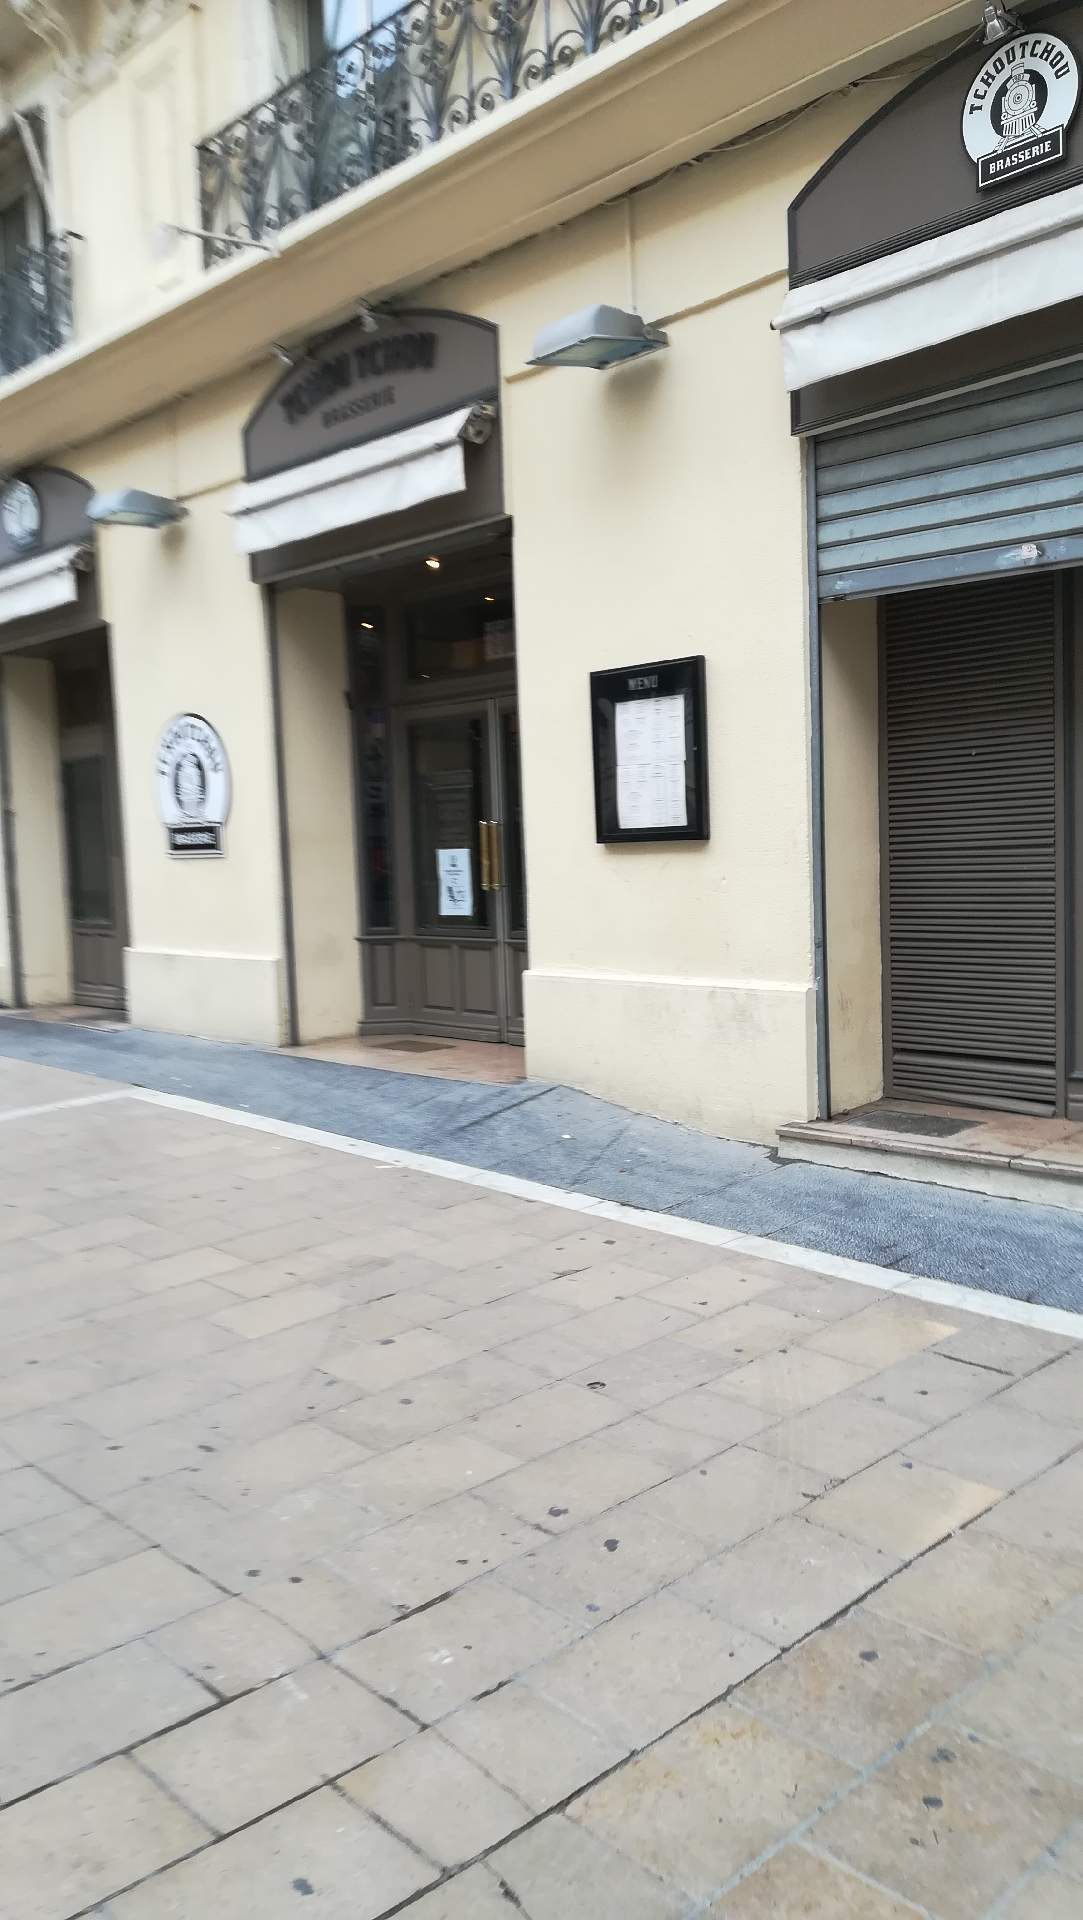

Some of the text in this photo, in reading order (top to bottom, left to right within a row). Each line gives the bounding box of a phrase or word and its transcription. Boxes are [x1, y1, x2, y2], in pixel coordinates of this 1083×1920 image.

[969, 40, 1071, 115] TCHOUTCHOU
[988, 140, 1053, 175] BRASSERIE
[628, 675, 658, 691] MENU
